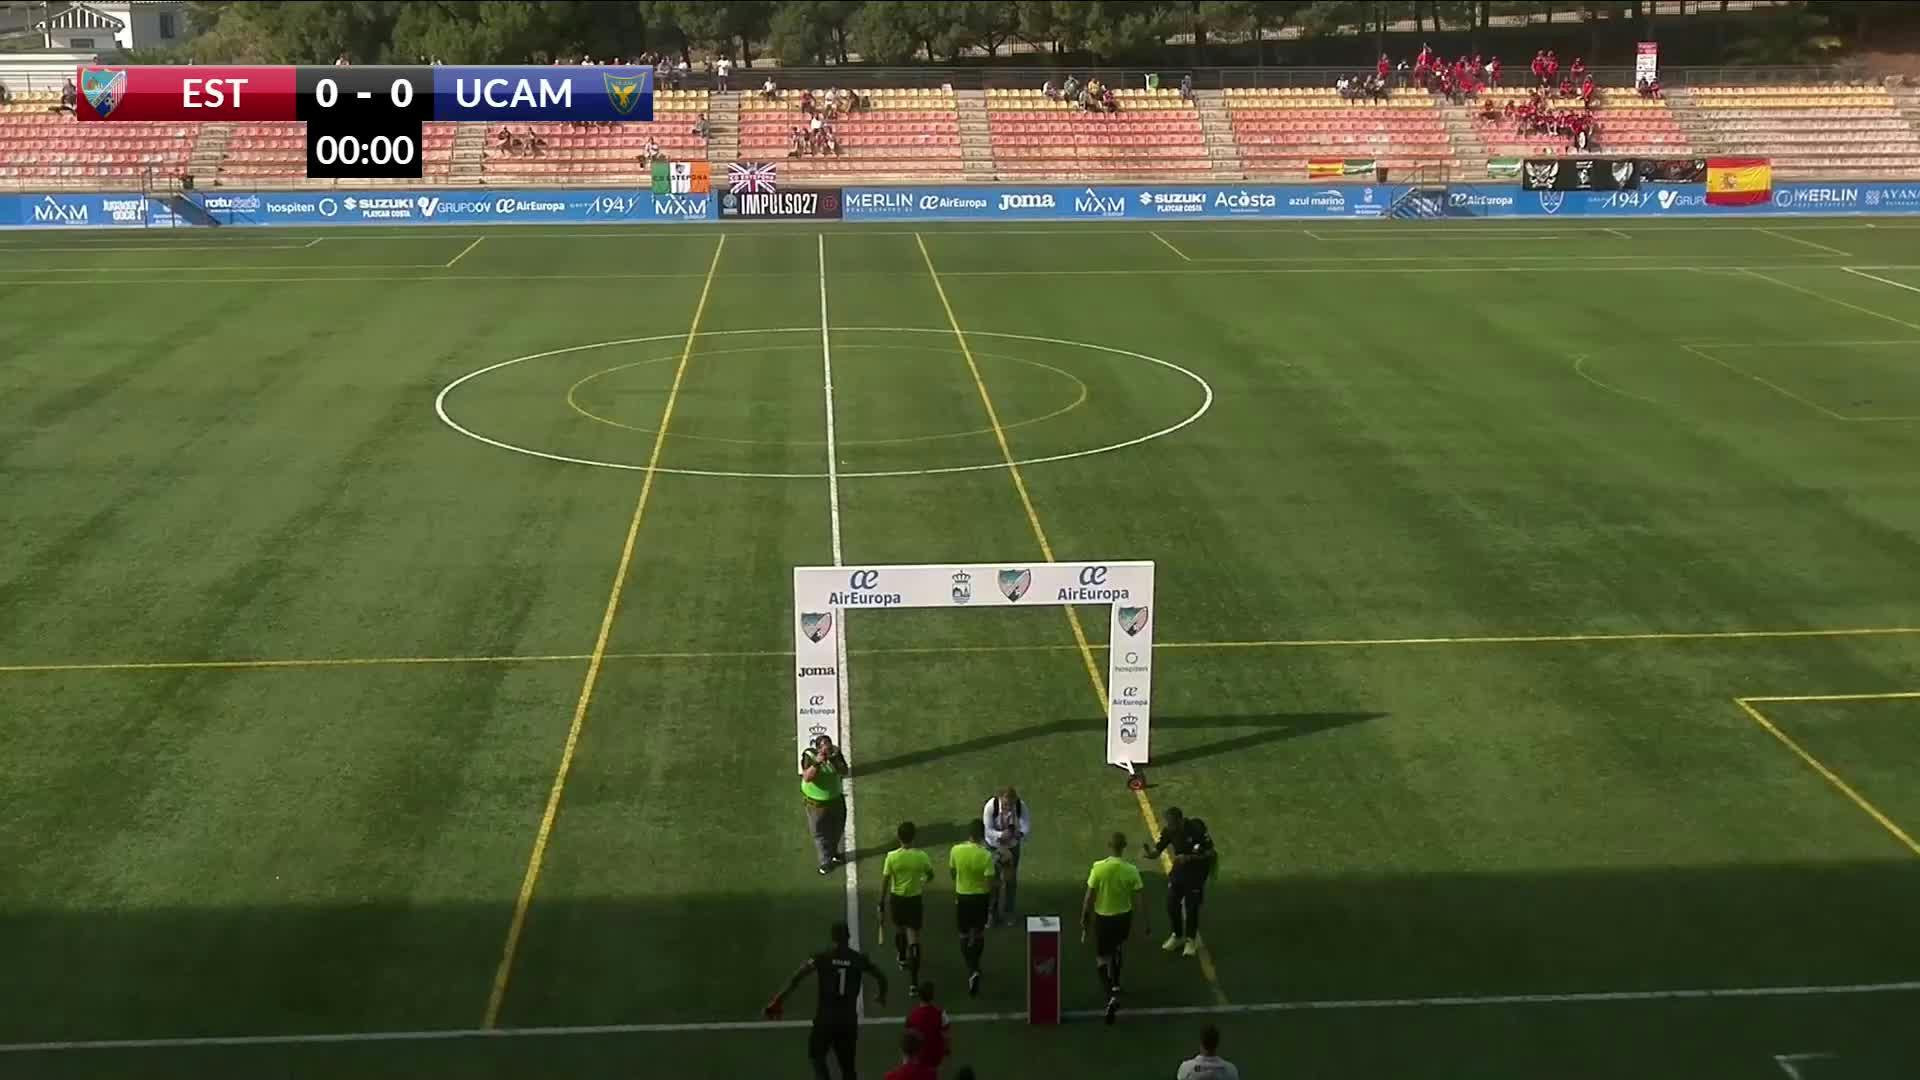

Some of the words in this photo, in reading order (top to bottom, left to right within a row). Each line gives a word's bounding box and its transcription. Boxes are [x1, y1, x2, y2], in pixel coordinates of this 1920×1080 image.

[846, 193, 913, 207] MERLIN
[1075, 188, 1125, 212] MXM
[1154, 194, 1207, 203] SUZUKI
[1214, 190, 1276, 208] Acosta
[1289, 196, 1310, 206] azul
[1311, 196, 1345, 206] marino
[1467, 195, 1513, 207] AirEuropa
[1794, 188, 1858, 202] MERLIN
[34, 195, 88, 221] MXM
[267, 202, 315, 215] hospiten
[359, 198, 414, 209] SUZUKI
[516, 200, 565, 212] AirEuropa
[655, 195, 706, 215] MXM
[741, 193, 818, 215] IMPULSO27
[940, 197, 988, 210] AirEuropa
[828, 591, 902, 606] AirEuropa
[1058, 587, 1130, 603] AirEuropa
[1112, 698, 1148, 707] AirEuropa
[800, 707, 836, 716] AirEuropa
[836, 968, 847, 996] 1
